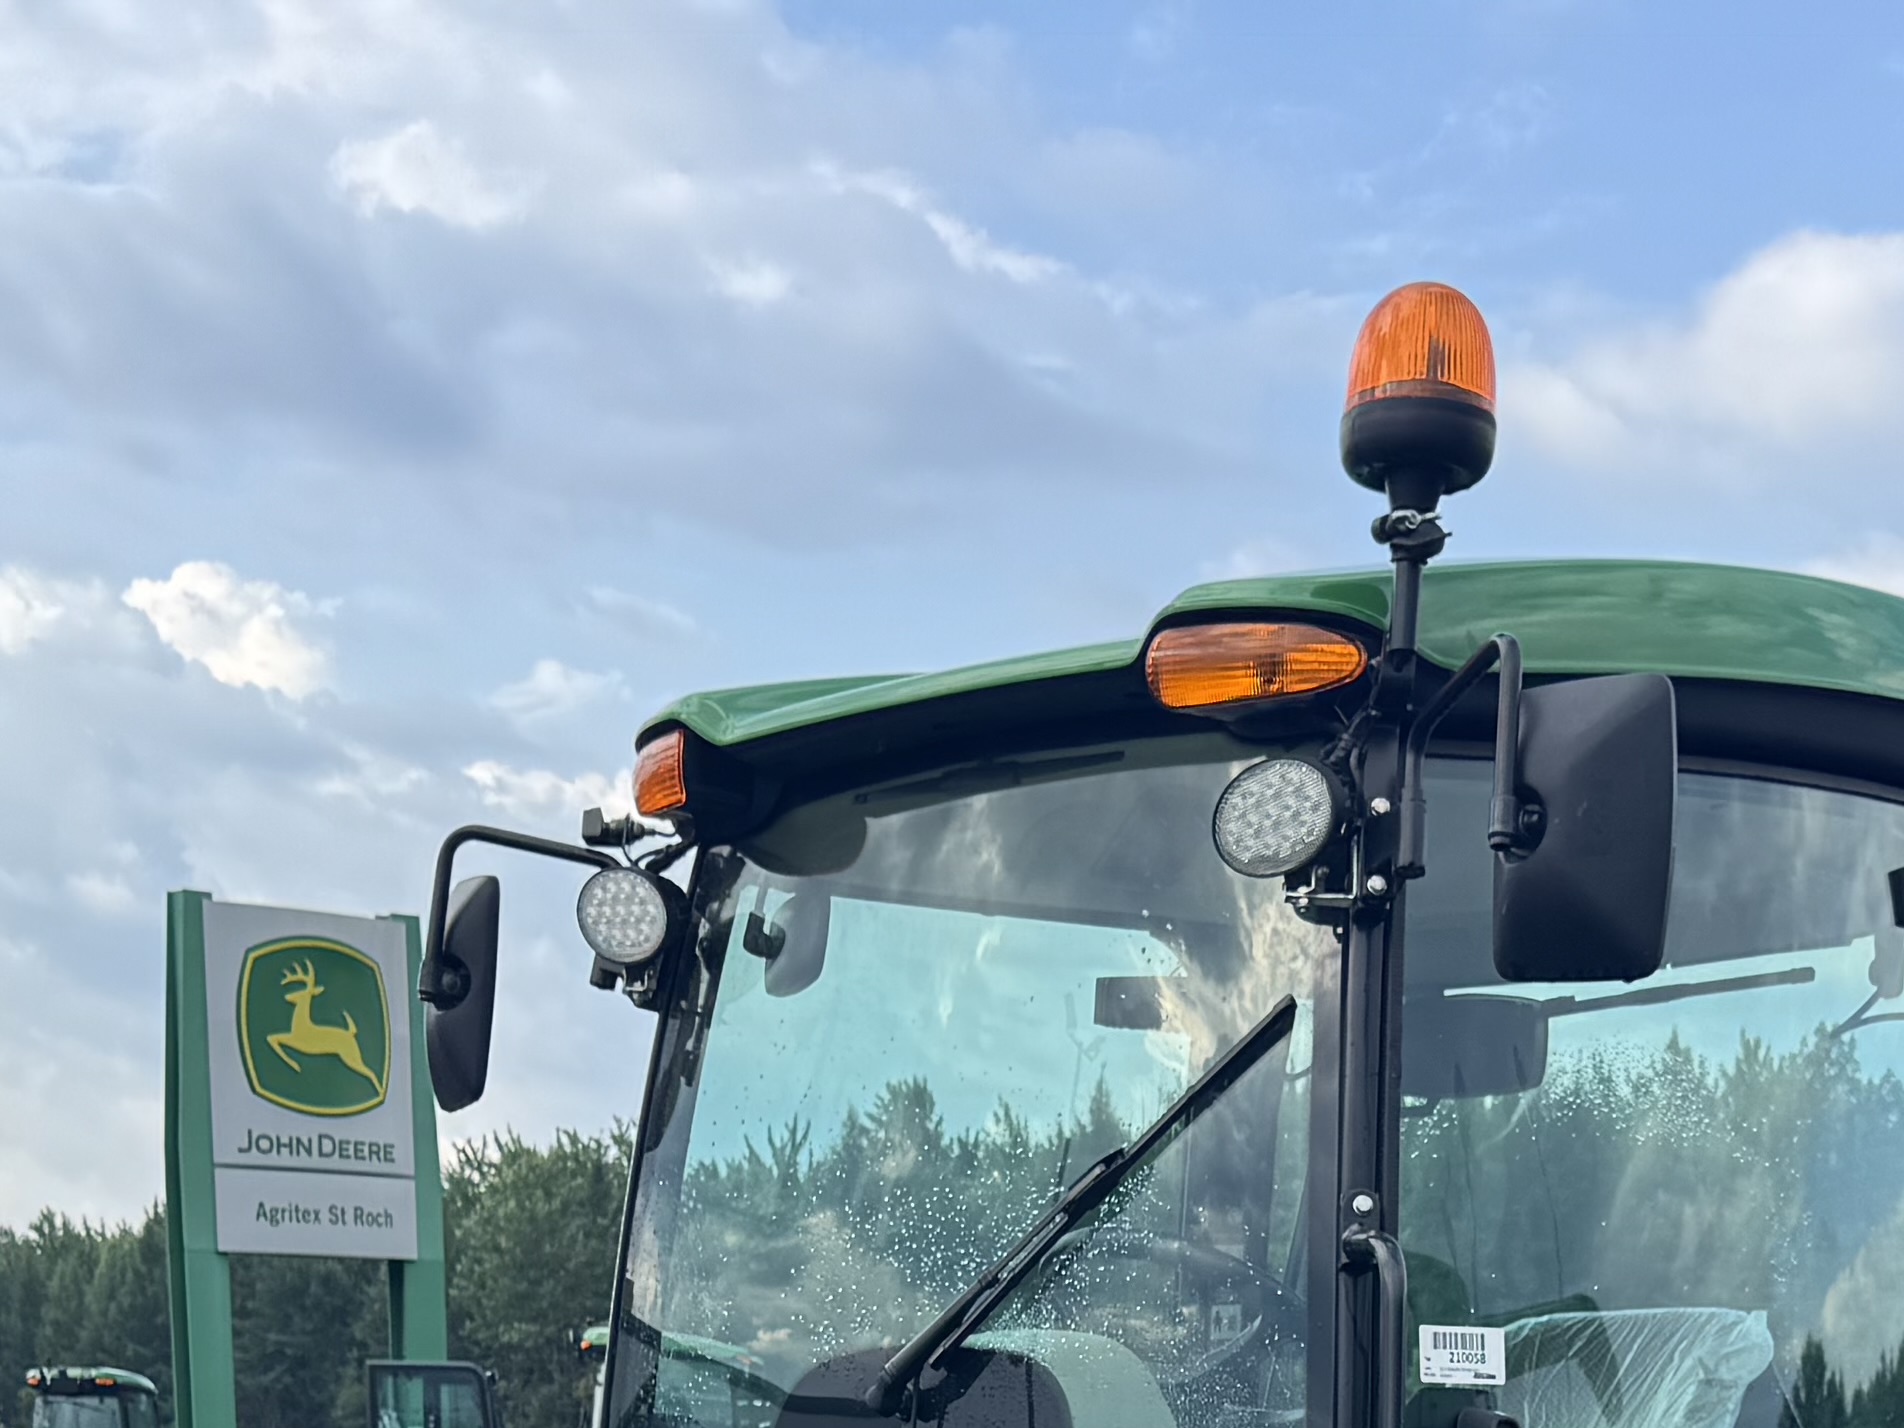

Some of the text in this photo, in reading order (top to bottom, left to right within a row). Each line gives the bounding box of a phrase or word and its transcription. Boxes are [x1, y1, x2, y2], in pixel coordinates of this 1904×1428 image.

[237, 1129, 396, 1164] JOHN DEERE
[255, 1201, 394, 1229] Agritex St Roch
[1448, 1351, 1487, 1365] 210058
